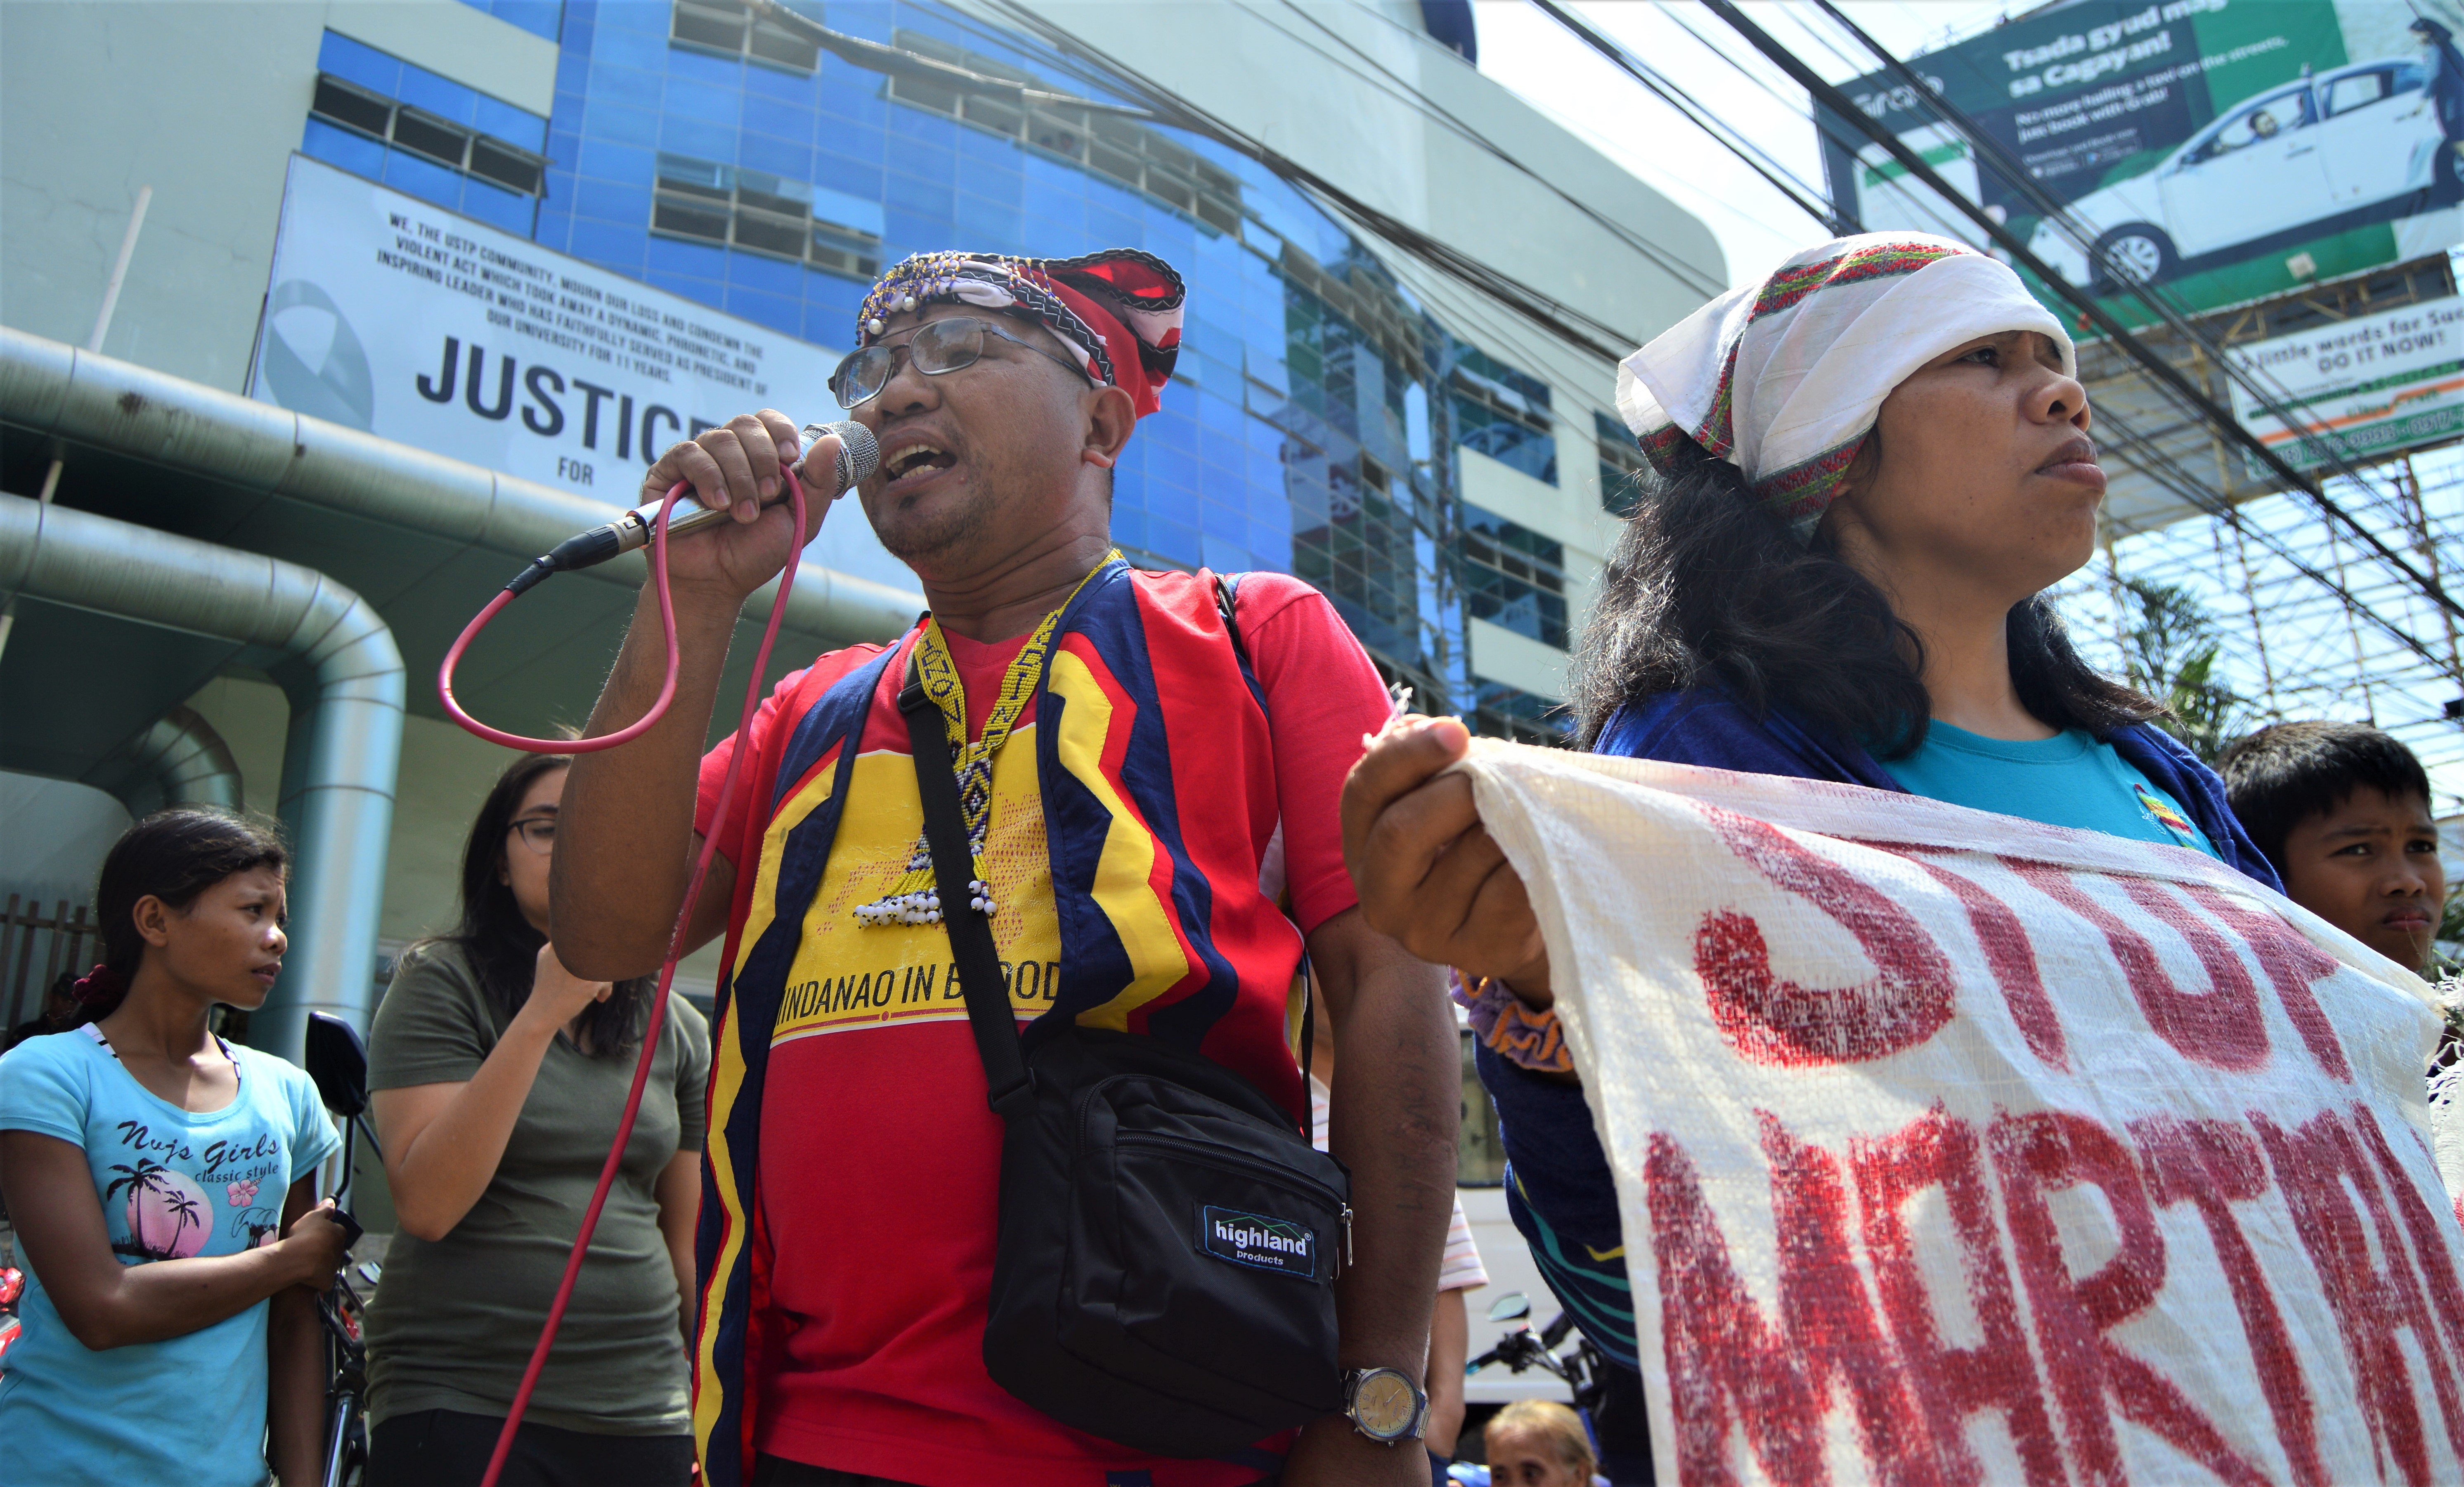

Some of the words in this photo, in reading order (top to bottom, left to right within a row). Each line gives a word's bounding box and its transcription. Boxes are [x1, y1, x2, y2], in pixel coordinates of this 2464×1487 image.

[2003, 34, 2087, 72] Tsada
[2087, 5, 2161, 52] gyud
[2009, 74, 2043, 99] sa
[2043, 30, 2173, 88] Cagayan!
[396, 235, 449, 265] VIOLENT
[452, 256, 477, 276] ACT
[480, 265, 522, 291] WHICH
[524, 280, 555, 304] TOOK
[558, 295, 594, 318] AWAY
[596, 306, 605, 322] A
[734, 357, 757, 375] AND
[417, 222, 441, 242] THE
[445, 233, 478, 254] USTP
[560, 275, 602, 302] MOURN
[605, 291, 628, 311] OUR
[631, 299, 659, 323] LOSS
[662, 314, 685, 331] AND
[688, 321, 741, 352] CONDEMN
[743, 341, 764, 360] THE
[376, 249, 442, 284] INSPIRING
[445, 272, 494, 302] LEADER
[497, 292, 525, 313] WHO
[528, 303, 553, 323] HAS
[556, 312, 626, 348] FAITHFULLY
[628, 338, 672, 365] SERVED
[675, 354, 690, 372] AS
[693, 360, 752, 392] PRESIDENT
[487, 308, 511, 331] OUR
[514, 318, 585, 355] UNIVERSITY
[588, 343, 611, 364] FOR
[2389, 317, 2421, 337] for
[2317, 353, 2351, 372] DO
[2355, 345, 2375, 364] IT
[557, 456, 594, 485] FOR
[776, 970, 895, 1026] INDANAO
[901, 964, 936, 1004] IN
[195, 1167, 242, 1184] classic
[246, 1161, 279, 1181] style
[204, 1133, 280, 1174] Girls
[1216, 1220, 1306, 1256] highland
[1237, 1250, 1284, 1266] products
